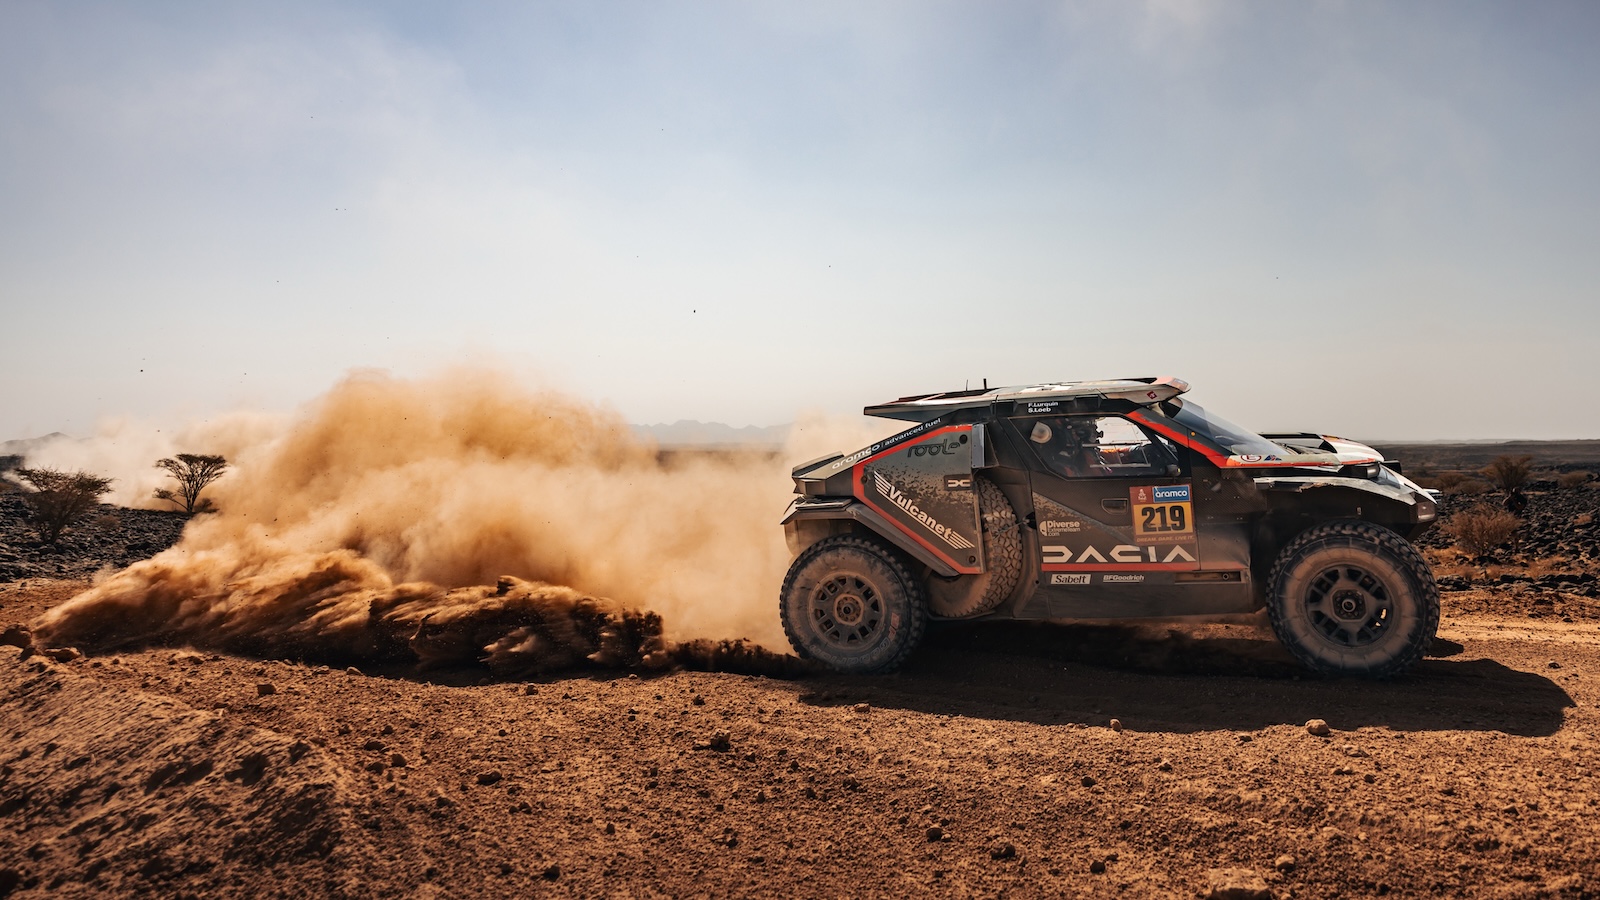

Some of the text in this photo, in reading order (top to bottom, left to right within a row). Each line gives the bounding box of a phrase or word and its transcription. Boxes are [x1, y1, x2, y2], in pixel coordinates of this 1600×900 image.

[832, 417, 941, 469] aramco advanced fuel
[1155, 490, 1188, 498] aramco
[887, 483, 953, 541] Vulcanet
[1141, 505, 1186, 532] 219
[1047, 520, 1080, 528] Diverse
[1041, 544, 1197, 563] DACIA
[1055, 574, 1087, 584] Sabelt
